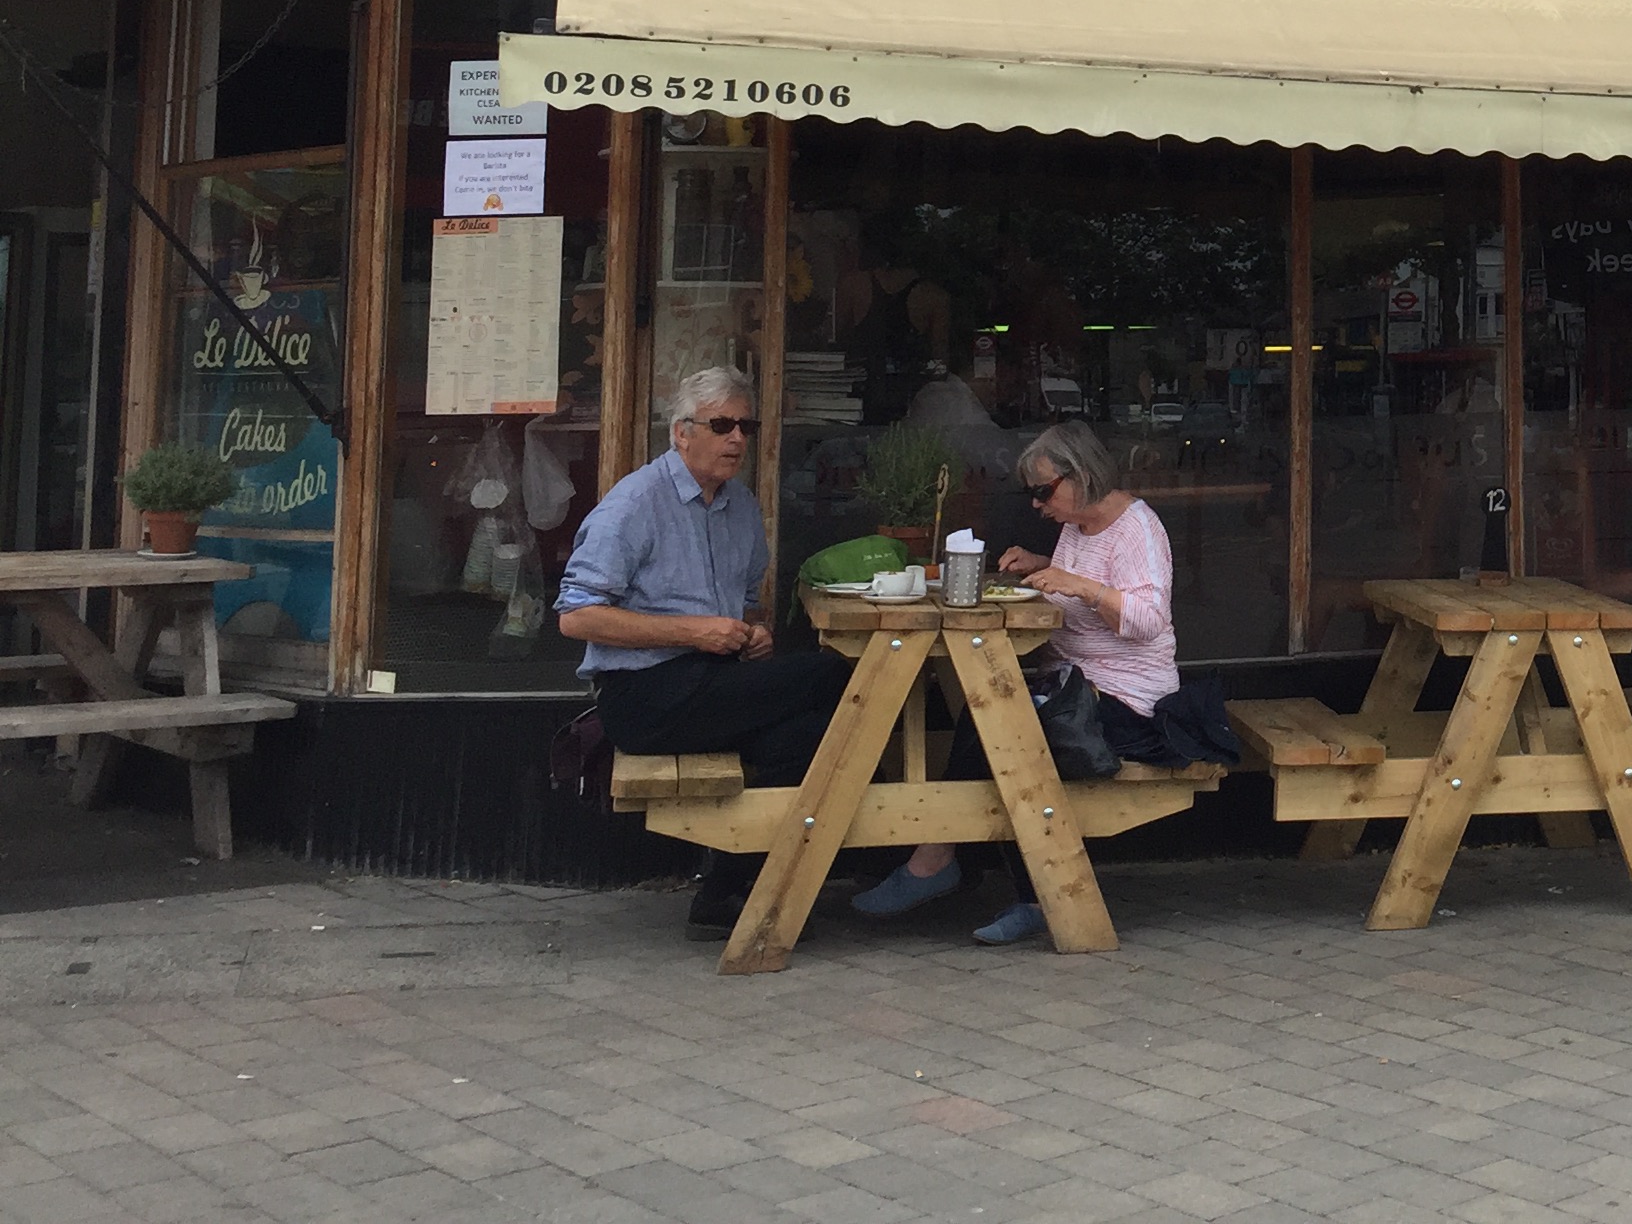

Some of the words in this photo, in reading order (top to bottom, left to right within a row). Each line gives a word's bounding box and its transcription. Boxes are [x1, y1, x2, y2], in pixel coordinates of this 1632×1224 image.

[472, 115, 523, 125] WANTED
[477, 100, 501, 108] CLEA
[193, 317, 227, 368] Le
[219, 407, 287, 463] Cakes
[261, 459, 328, 516] order
[1486, 488, 1506, 512] 12
